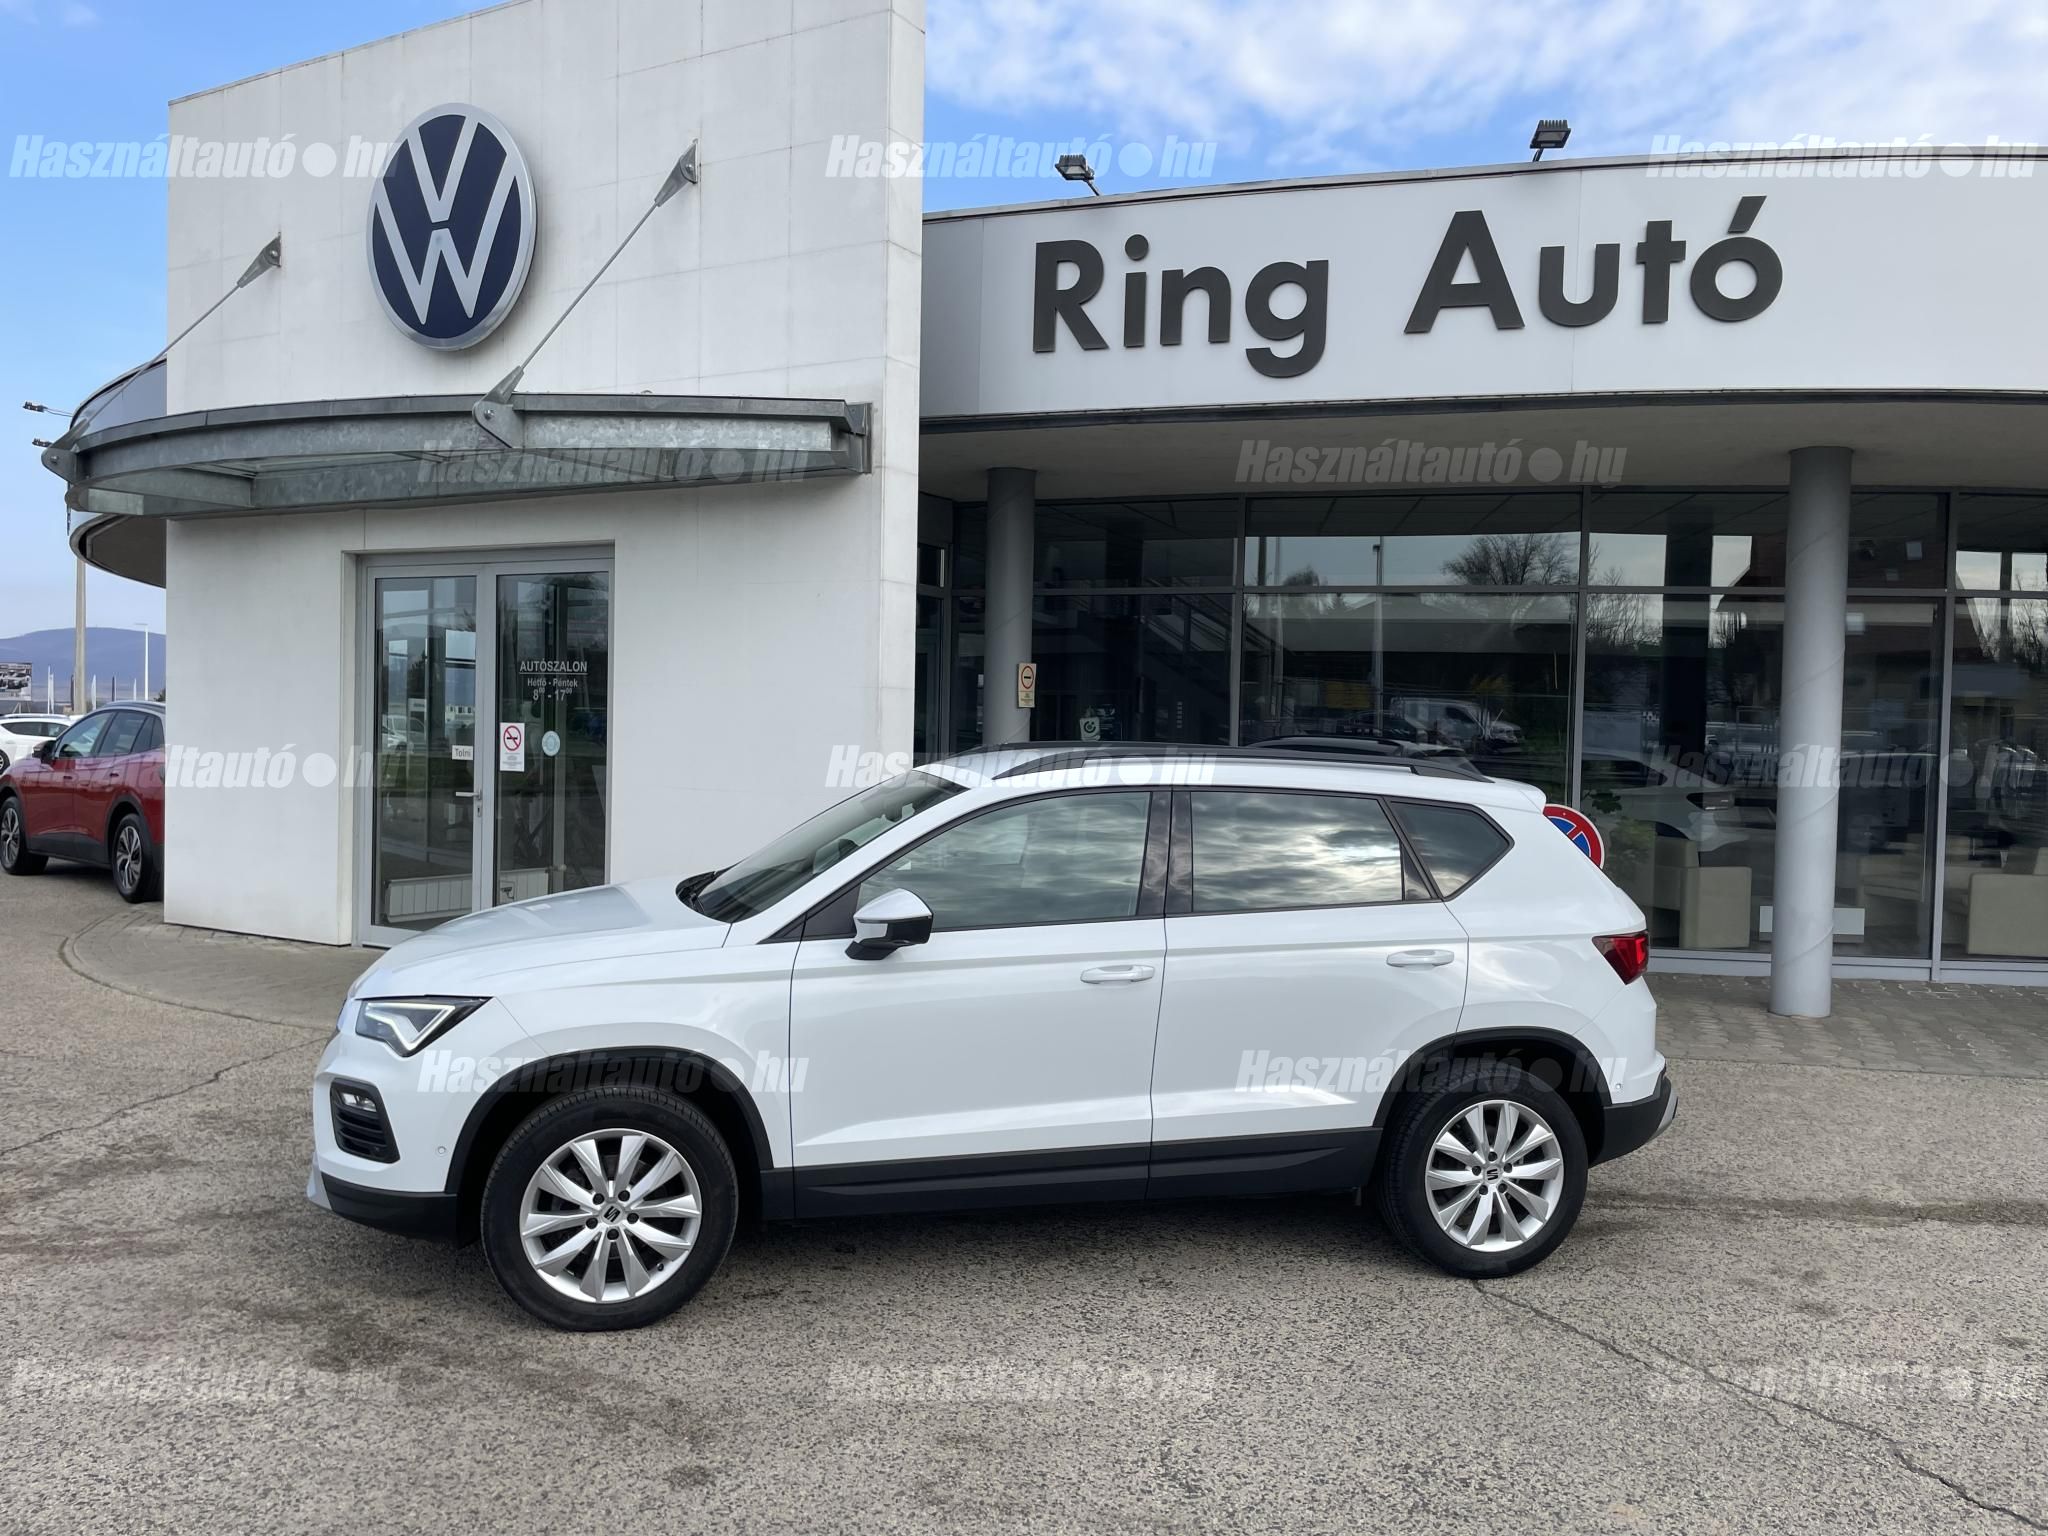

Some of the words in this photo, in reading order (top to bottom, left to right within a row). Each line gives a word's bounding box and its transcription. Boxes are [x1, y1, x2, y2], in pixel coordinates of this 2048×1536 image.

[1033, 233, 1329, 376] Ring
[1404, 195, 1783, 334] Autó
[519, 658, 588, 672] AUTÓSZALON
